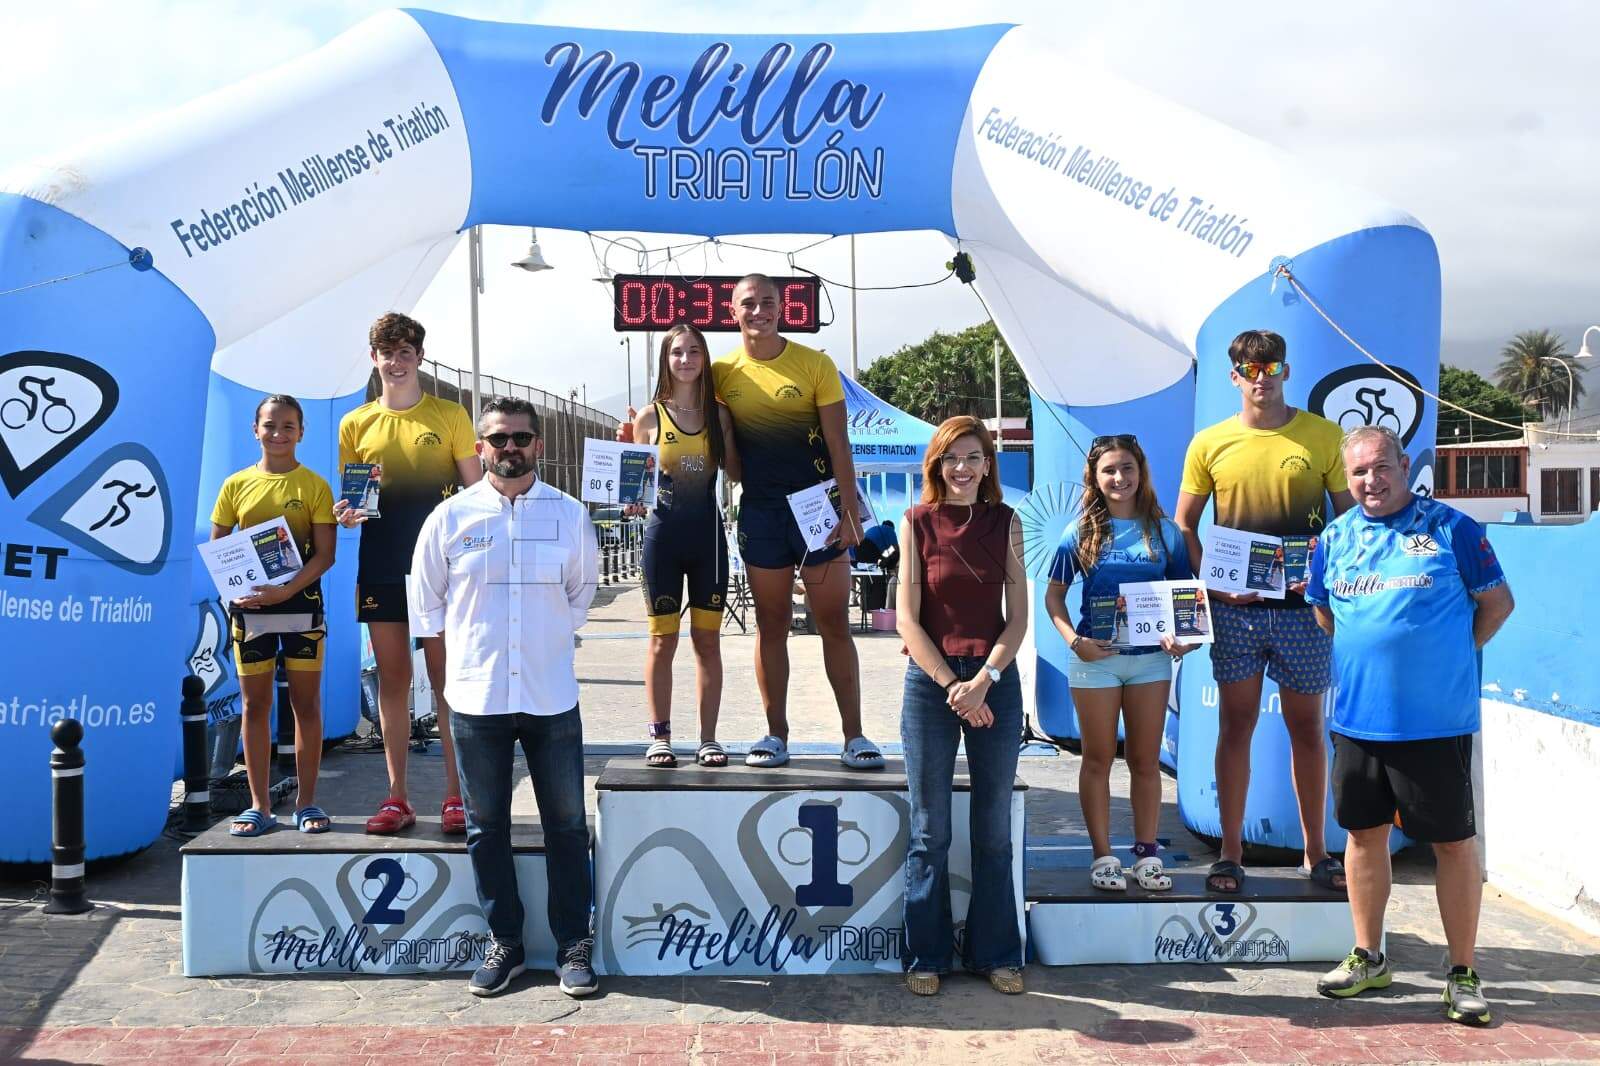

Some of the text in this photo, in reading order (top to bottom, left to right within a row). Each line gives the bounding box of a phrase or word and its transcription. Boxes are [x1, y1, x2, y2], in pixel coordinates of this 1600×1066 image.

[541, 41, 886, 149] Melilla
[170, 101, 450, 258] Federación Melillense de Triatlón
[633, 128, 885, 201] TRIATLÓN
[977, 106, 1254, 258] Federación Melillense de Triatlón
[590, 478, 614, 492] 60 €
[824, 518, 834, 530] €
[0, 543, 69, 580] ET
[228, 568, 257, 588] 40 €
[1210, 566, 1225, 579] 30
[1228, 568, 1239, 582] €
[1334, 574, 1384, 596] Melilla
[0, 590, 152, 623] lense de Triatlón
[1135, 620, 1166, 634] 30 €
[796, 805, 854, 907] 1
[362, 857, 406, 925] 2
[1214, 903, 1236, 936] 3
[271, 923, 487, 972] Melilla TRIATLÓN
[657, 904, 820, 973] Melilla
[1154, 932, 1290, 962] Melilla TRIATLÓN
